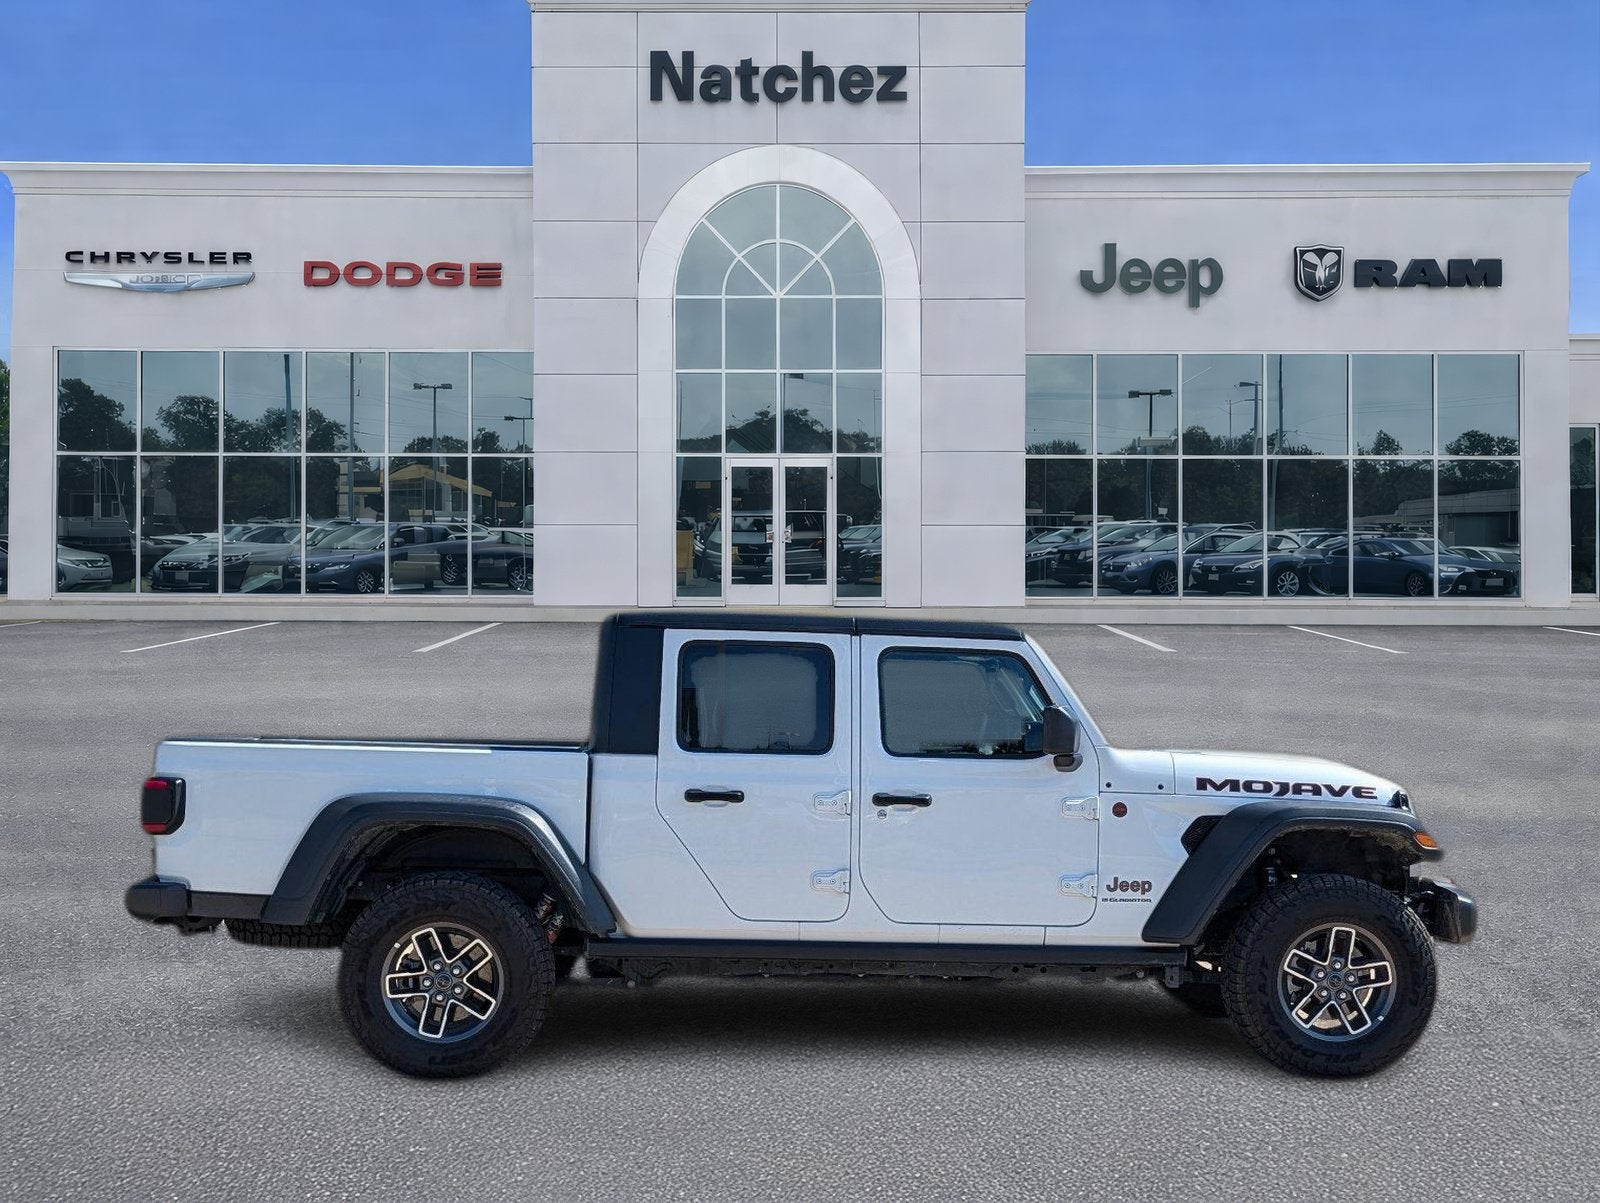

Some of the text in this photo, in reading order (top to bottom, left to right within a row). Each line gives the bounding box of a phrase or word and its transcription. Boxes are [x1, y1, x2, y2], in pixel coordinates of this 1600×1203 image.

[650, 50, 908, 104] Natchez
[65, 251, 253, 265] CHRYSLER
[303, 261, 502, 287] DODGE
[1080, 242, 1223, 309] Jeep
[1353, 258, 1503, 288] RAM
[1195, 777, 1378, 800] MOJAVE
[1106, 876, 1152, 895] Jeep
